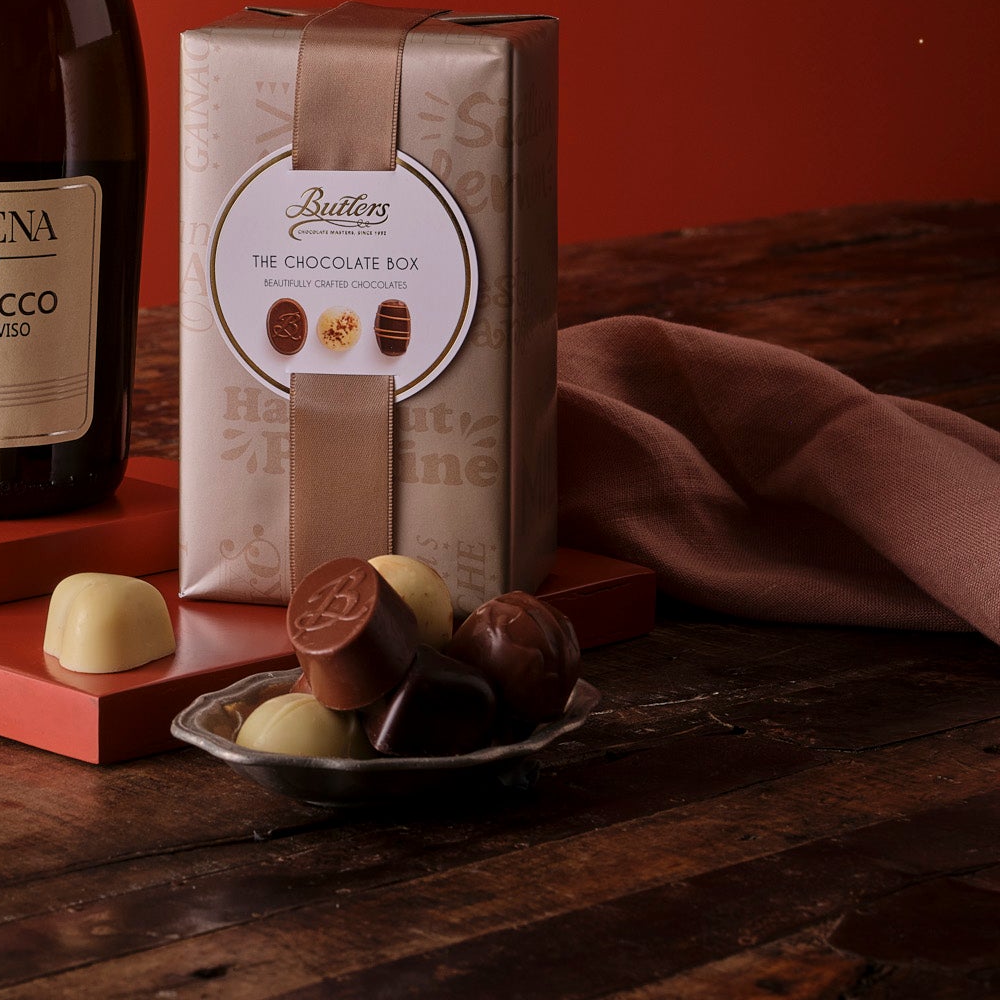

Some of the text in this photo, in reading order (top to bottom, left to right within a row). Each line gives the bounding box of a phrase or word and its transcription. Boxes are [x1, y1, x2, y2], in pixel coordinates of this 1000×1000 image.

[285, 186, 390, 228] Butlers
[252, 255, 419, 270] THE CHOCOLATE BOX
[264, 279, 407, 290] BEAUTIFULLY CRAFTED CHOCOLATES
